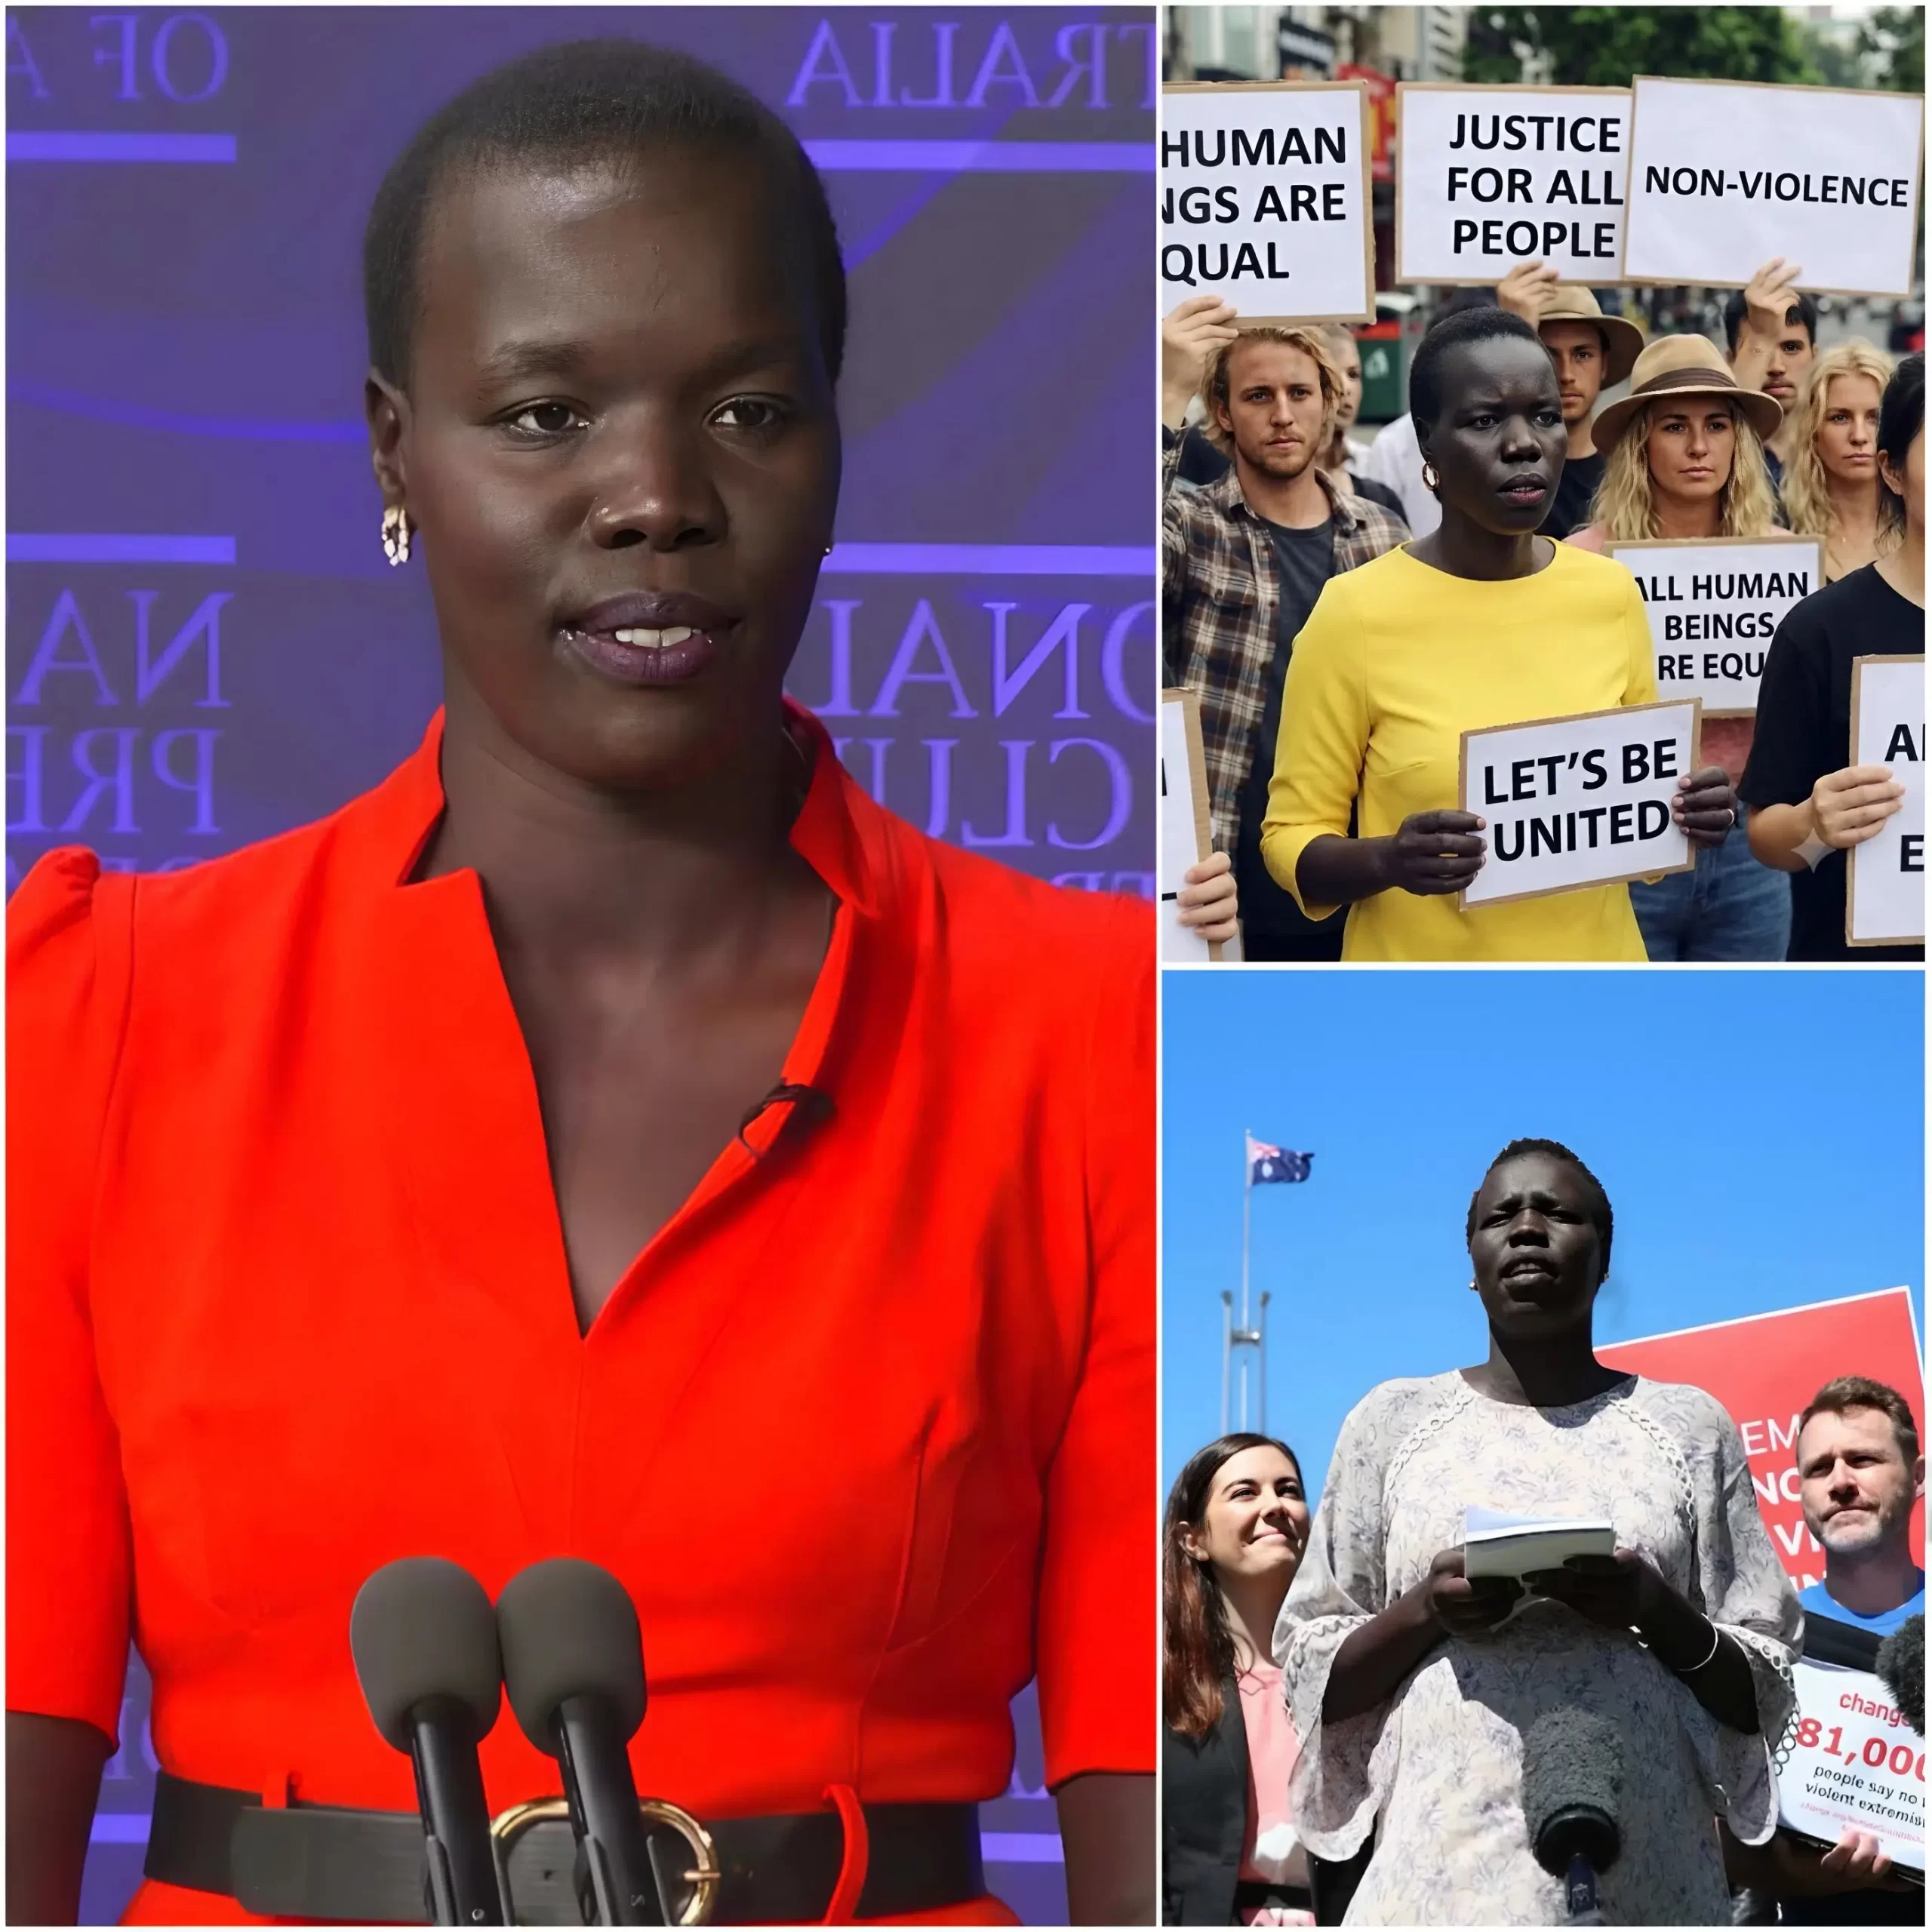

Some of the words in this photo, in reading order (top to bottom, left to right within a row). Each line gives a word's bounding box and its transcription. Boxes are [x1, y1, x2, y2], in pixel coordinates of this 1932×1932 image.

[1162, 126, 1346, 168] HUMAN
[1450, 115, 1620, 152] JUSTICE
[1254, 184, 1346, 223] ARE
[1447, 167, 1534, 204] FOR
[1546, 170, 1624, 205] ALL
[1645, 166, 1909, 207] NON-VIOLENCE
[1454, 220, 1616, 257] PEOPLE
[1162, 242, 1290, 286] QUAL
[1693, 572, 1808, 600] HUMAN
[1665, 612, 1774, 641] BEINGS
[1484, 749, 1607, 805] LET’S
[1622, 738, 1678, 784] BE
[1494, 800, 1670, 862] UNITED
[1813, 1766, 1864, 1789] people
[1868, 1782, 1894, 1800] say
[1898, 1791, 1918, 1804] no
[1805, 1783, 1855, 1806] violent
[1859, 1800, 1925, 1828] extremis
